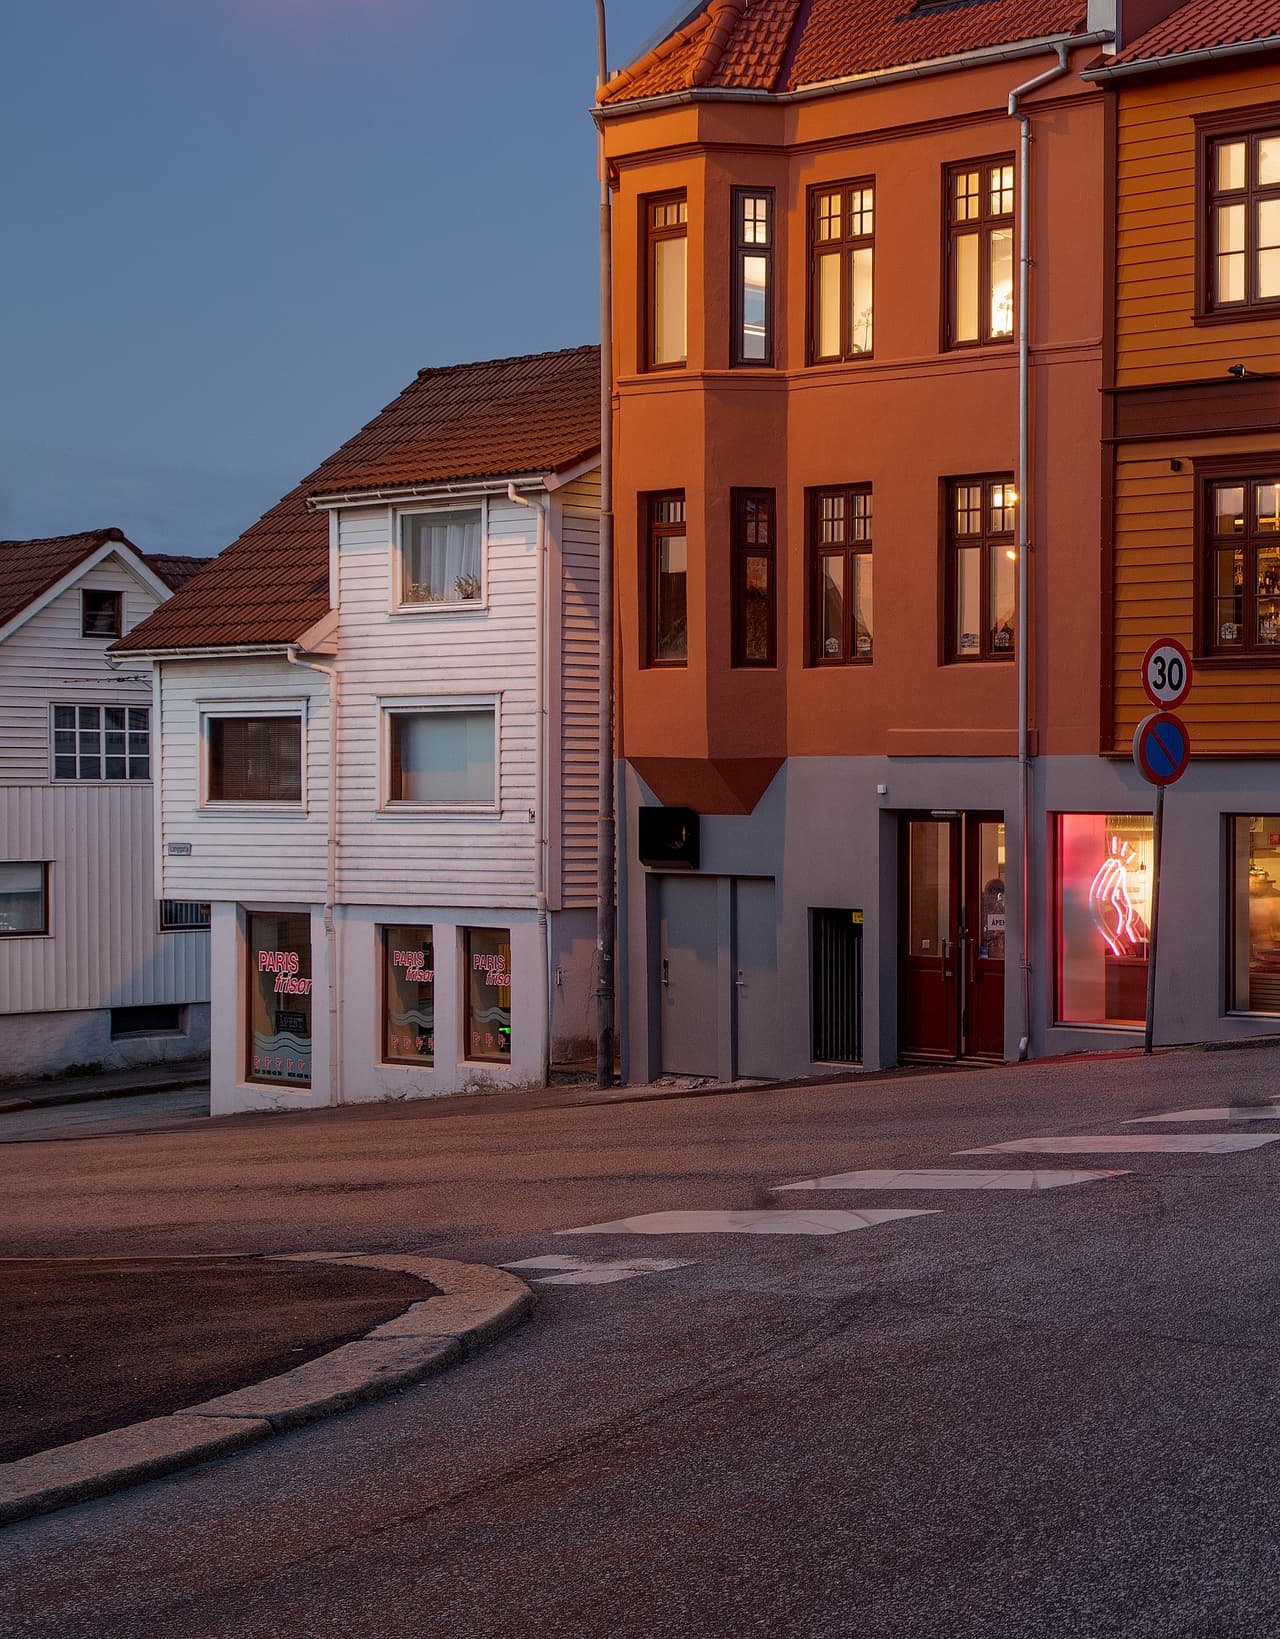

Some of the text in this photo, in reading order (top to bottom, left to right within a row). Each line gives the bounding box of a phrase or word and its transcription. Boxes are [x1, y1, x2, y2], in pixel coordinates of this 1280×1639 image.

[1152, 655, 1184, 691] 30
[258, 950, 299, 973] PARIS
[393, 951, 425, 968] PARIS
[473, 954, 506, 971] PARIS
